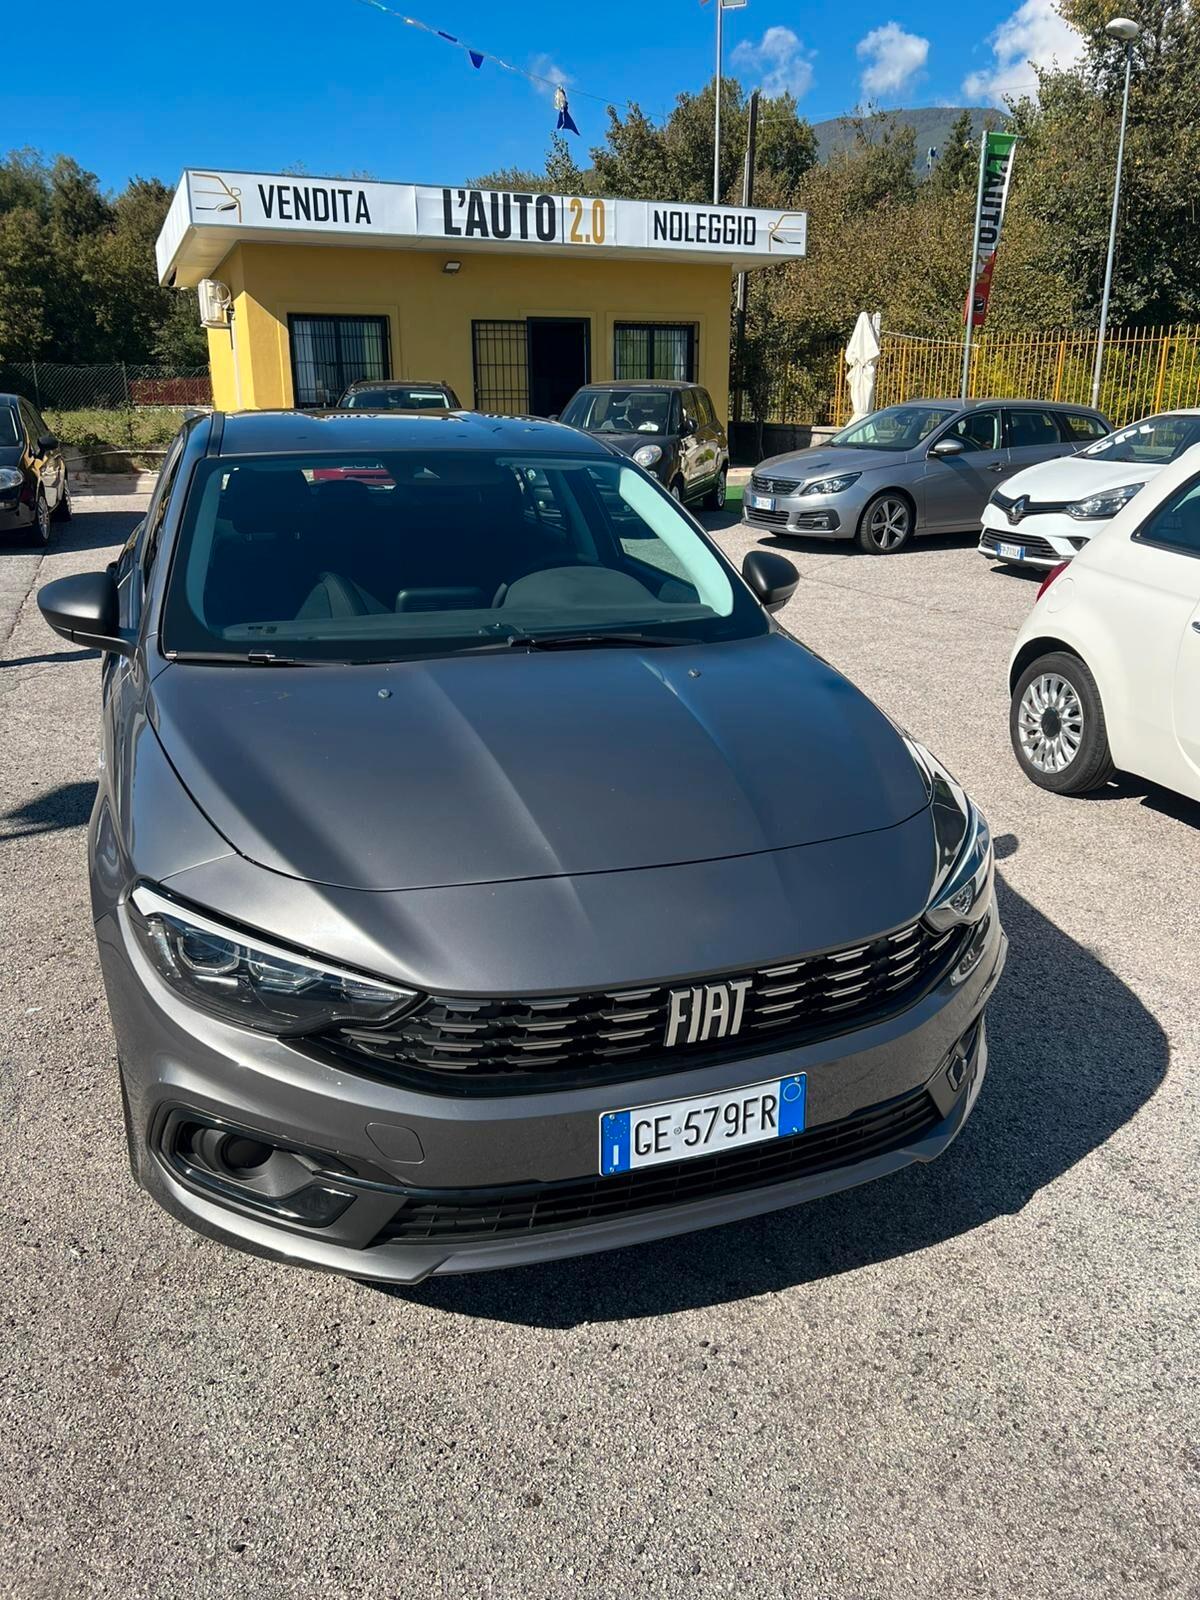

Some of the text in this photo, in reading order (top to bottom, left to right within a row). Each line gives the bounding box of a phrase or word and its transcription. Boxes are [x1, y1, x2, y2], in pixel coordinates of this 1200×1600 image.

[257, 184, 372, 225] VENDITA
[442, 188, 605, 245] L'AUTO 2.0
[654, 210, 756, 246] NOLEGGIO
[664, 978, 753, 1047] FIAT
[633, 1094, 777, 1156] GE 579FR
